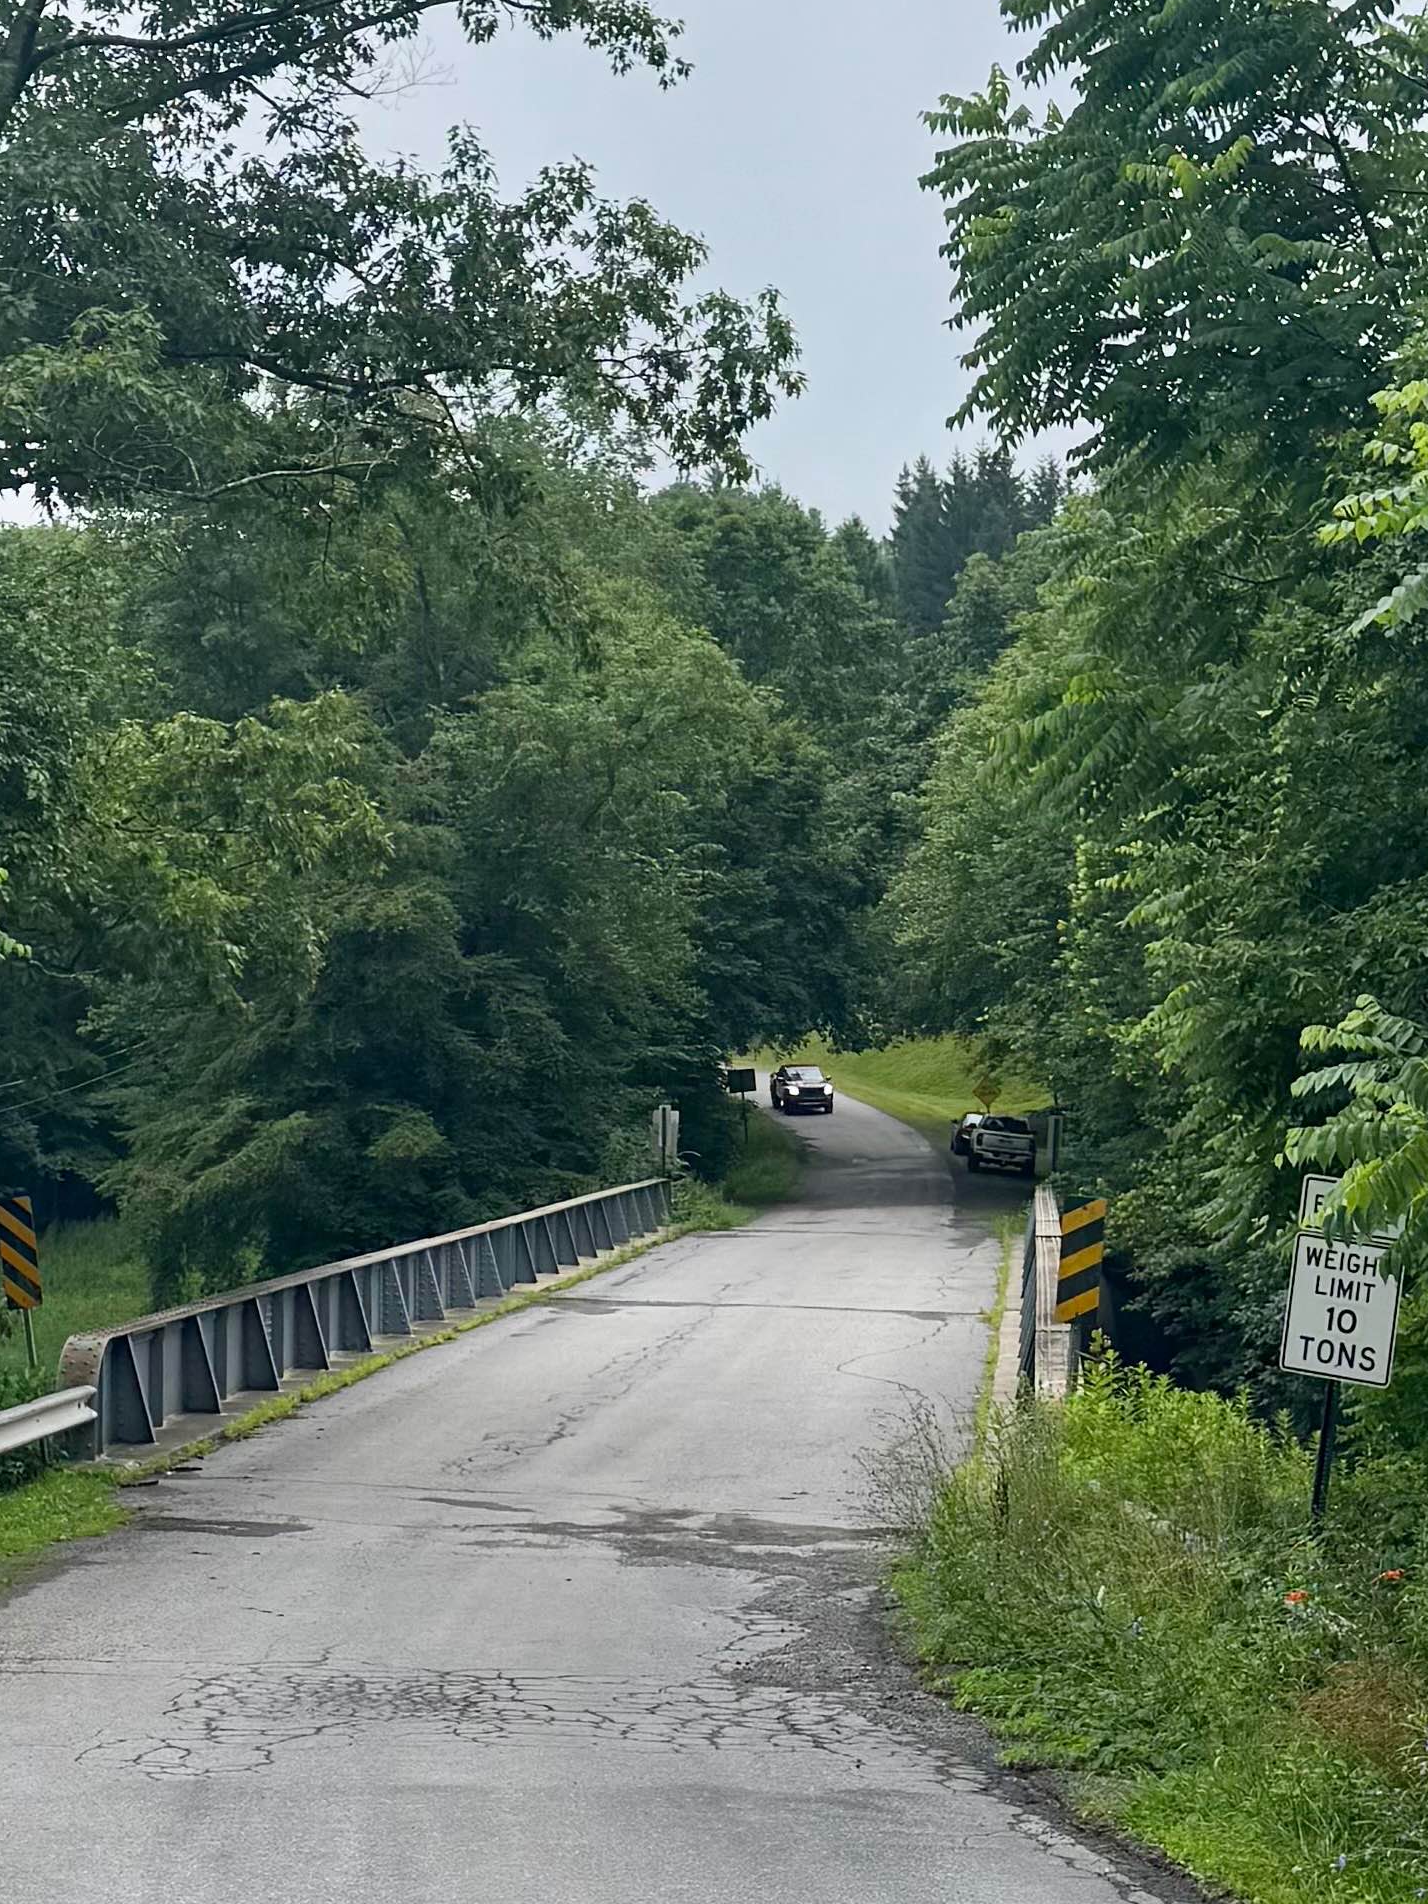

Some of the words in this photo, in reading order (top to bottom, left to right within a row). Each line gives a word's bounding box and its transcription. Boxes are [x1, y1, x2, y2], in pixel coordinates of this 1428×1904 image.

[1306, 1246, 1378, 1277] WEIGH
[1315, 1274, 1376, 1303] LIMIT
[1326, 1306, 1358, 1334] 10
[1299, 1335, 1376, 1371] TONS
